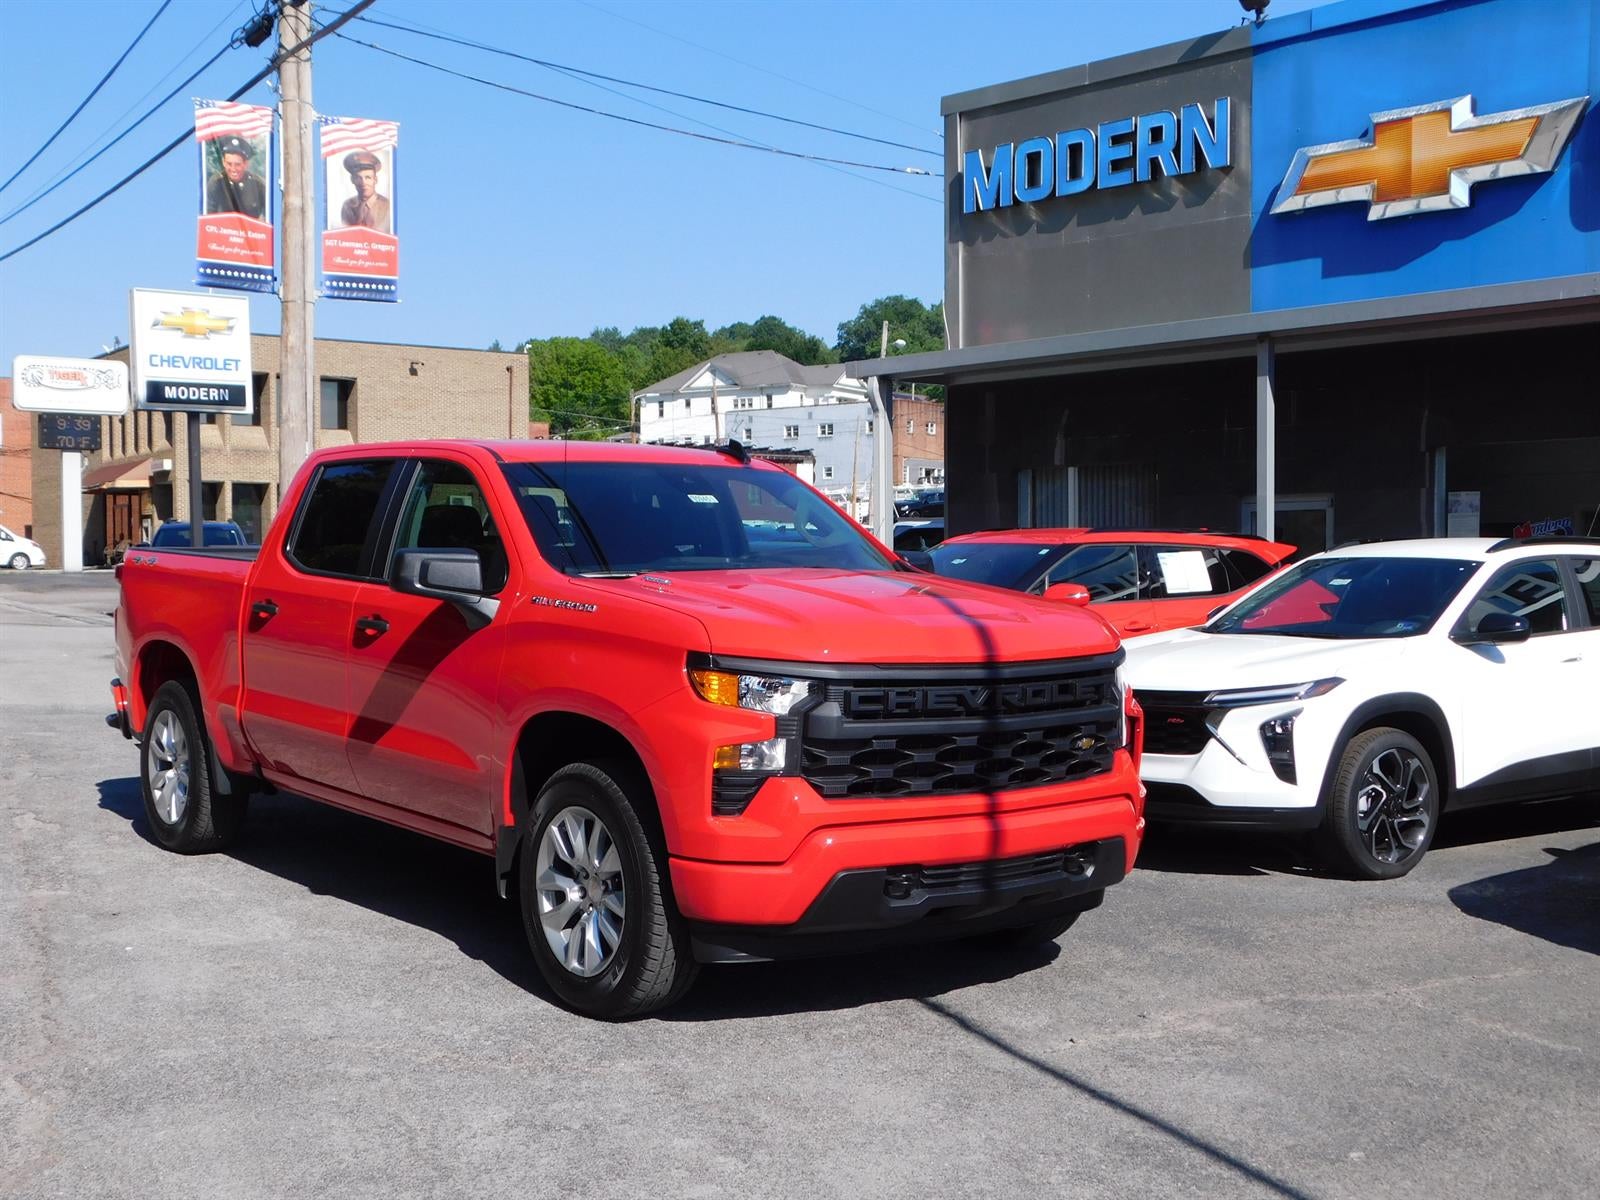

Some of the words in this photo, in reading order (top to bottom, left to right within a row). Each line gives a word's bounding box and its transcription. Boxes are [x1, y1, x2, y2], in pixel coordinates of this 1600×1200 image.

[963, 96, 1231, 214] MODERN
[149, 354, 241, 371] CHEVROLET
[165, 385, 229, 401] MODERN
[57, 418, 91, 431] 9:39
